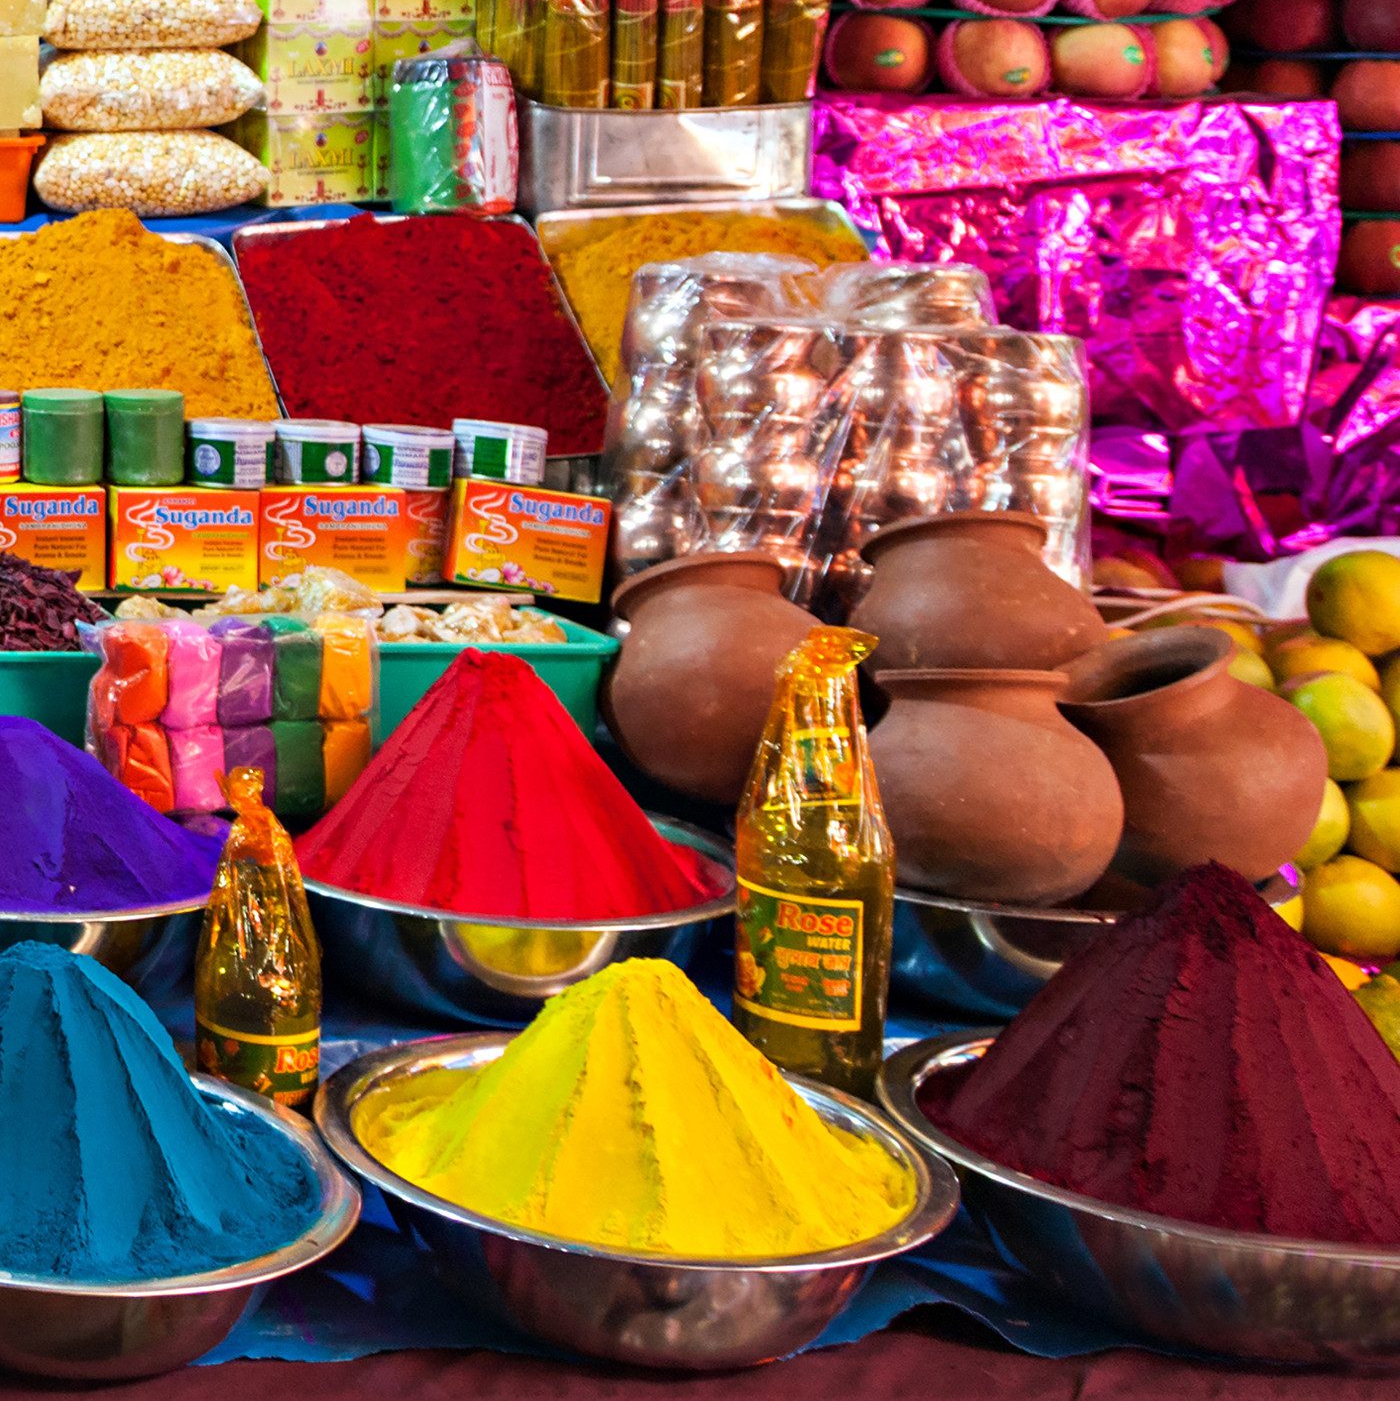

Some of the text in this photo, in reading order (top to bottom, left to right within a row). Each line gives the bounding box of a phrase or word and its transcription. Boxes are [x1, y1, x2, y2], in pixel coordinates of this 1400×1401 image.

[288, 58, 353, 77] LAXMI
[290, 150, 353, 168] LAXMI
[4, 497, 99, 521] Suganda
[154, 505, 254, 529] Suganda
[303, 496, 400, 520] Suganda
[509, 493, 606, 525] Suganda
[777, 901, 854, 937] Rose
[807, 935, 851, 951] WATER
[274, 1046, 318, 1073] Ros
